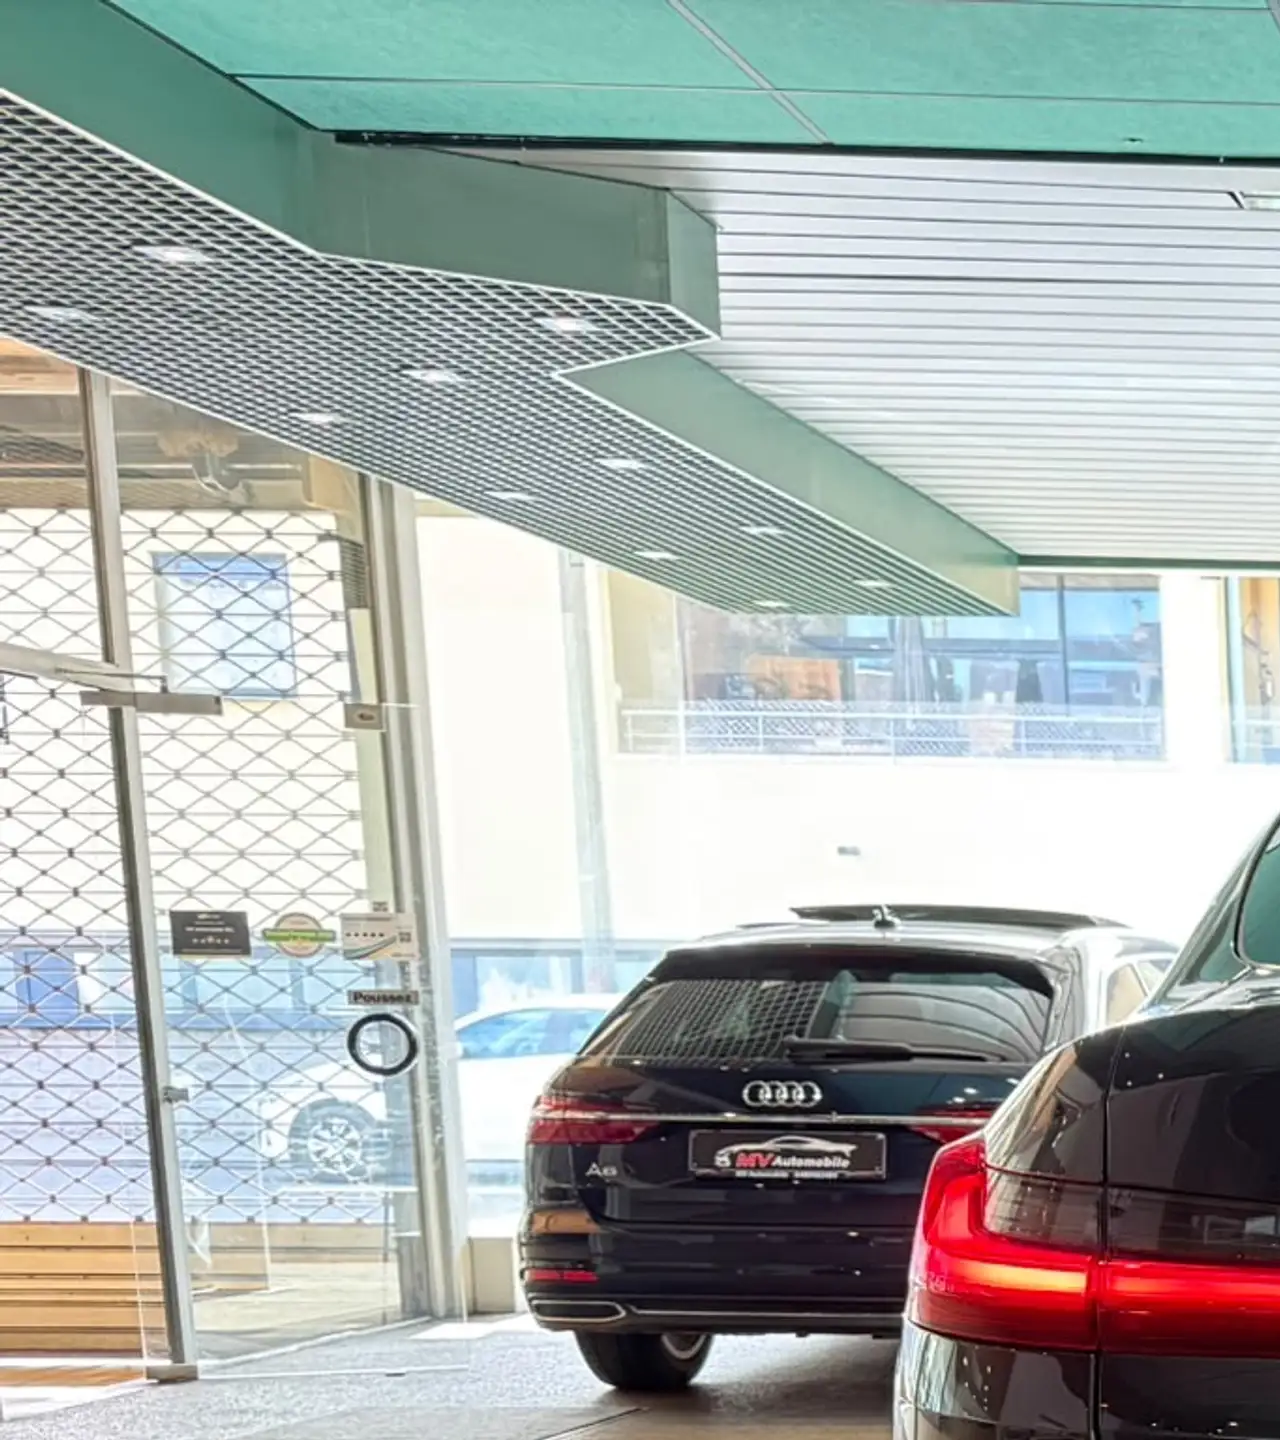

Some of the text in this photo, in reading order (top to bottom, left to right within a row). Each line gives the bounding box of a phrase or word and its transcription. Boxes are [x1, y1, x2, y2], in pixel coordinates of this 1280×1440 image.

[735, 1152, 850, 1169] MV Automobile
[585, 1162, 617, 1177] A6
